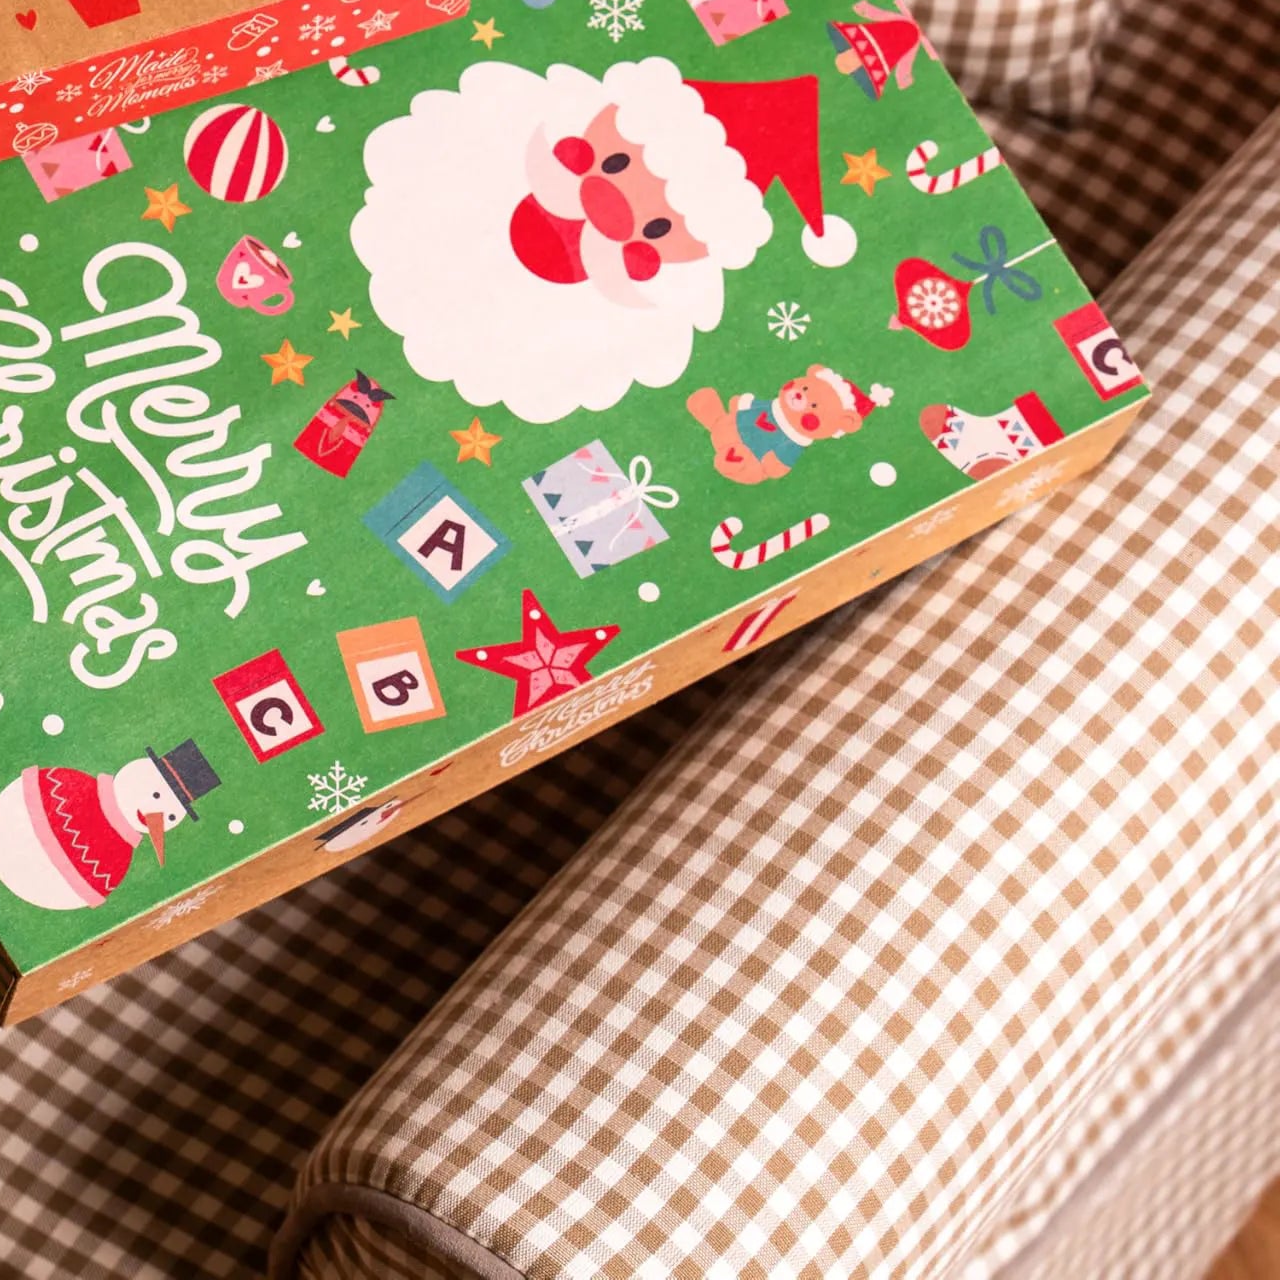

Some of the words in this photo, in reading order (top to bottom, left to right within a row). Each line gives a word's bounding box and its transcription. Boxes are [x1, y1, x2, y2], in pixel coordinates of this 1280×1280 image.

[87, 66, 199, 117] Moments
[89, 47, 199, 90] Made
[1092, 338, 1133, 376] C
[60, 241, 308, 619] Merry
[417, 519, 466, 571] A
[372, 669, 419, 706] B
[520, 660, 657, 732] Merry
[250, 697, 294, 737] C
[499, 675, 654, 768] Christmas
